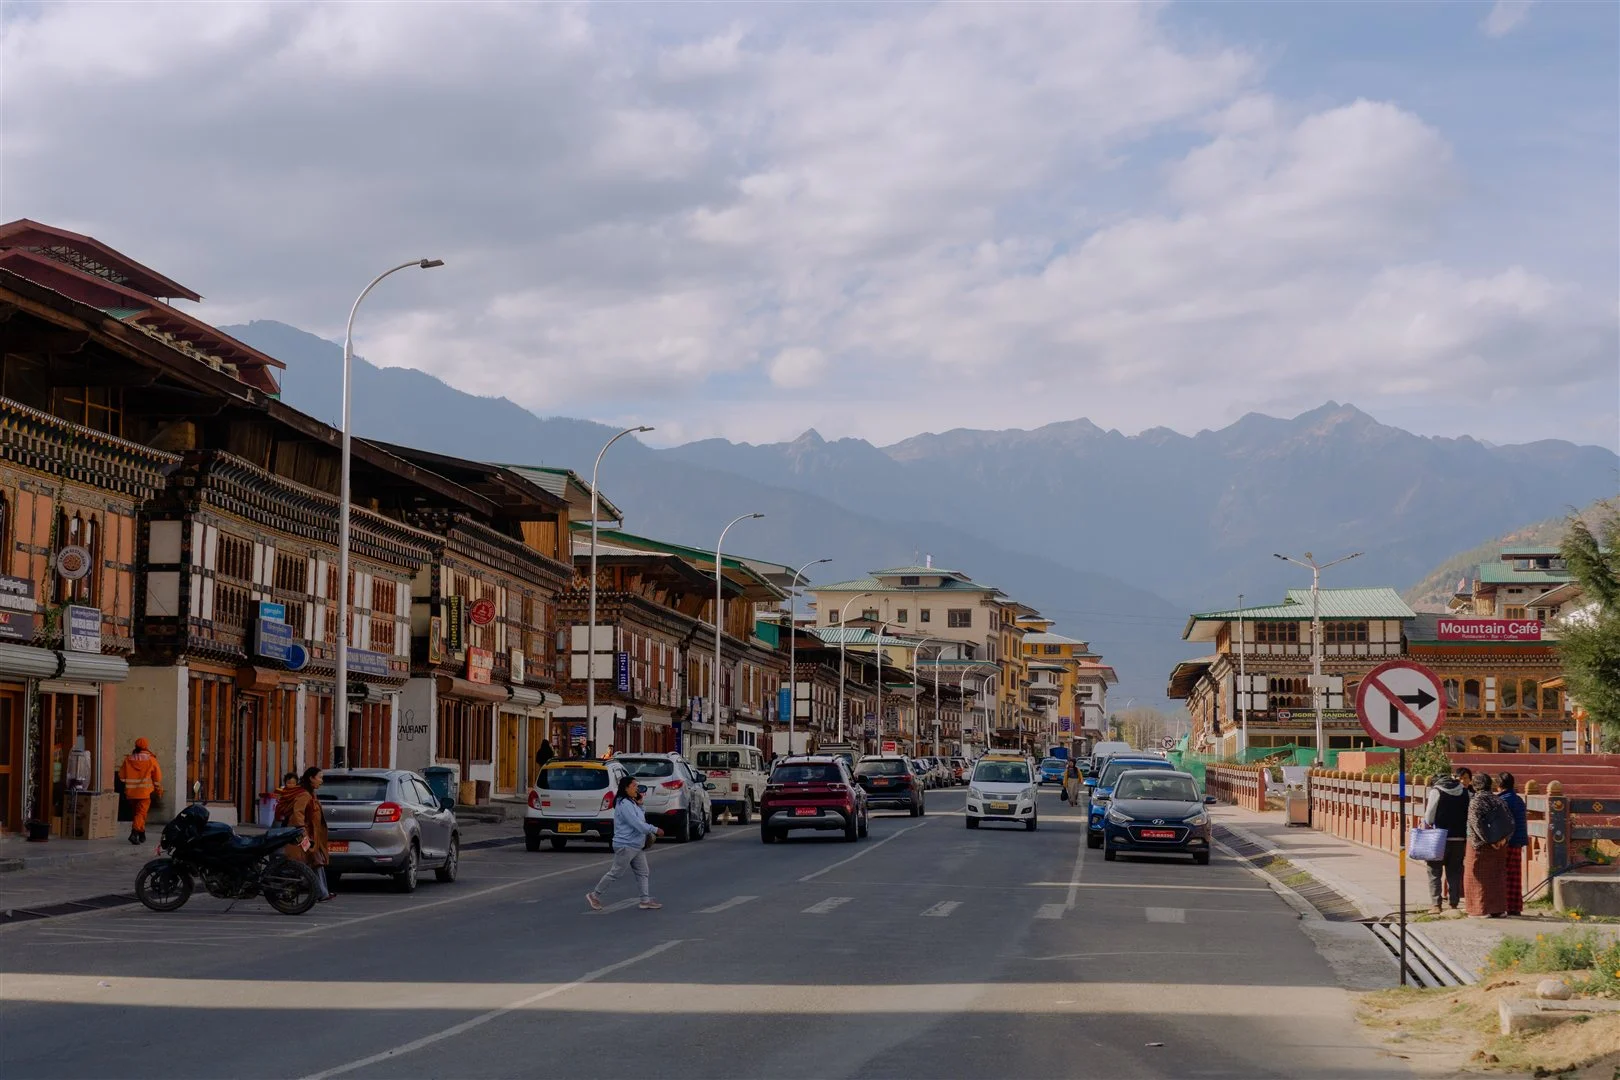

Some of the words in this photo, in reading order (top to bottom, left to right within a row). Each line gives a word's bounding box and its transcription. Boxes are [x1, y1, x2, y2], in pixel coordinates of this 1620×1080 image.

[1440, 622, 1505, 634] Mountain
[1508, 622, 1539, 634] Café
[398, 725, 428, 734] AURANT
